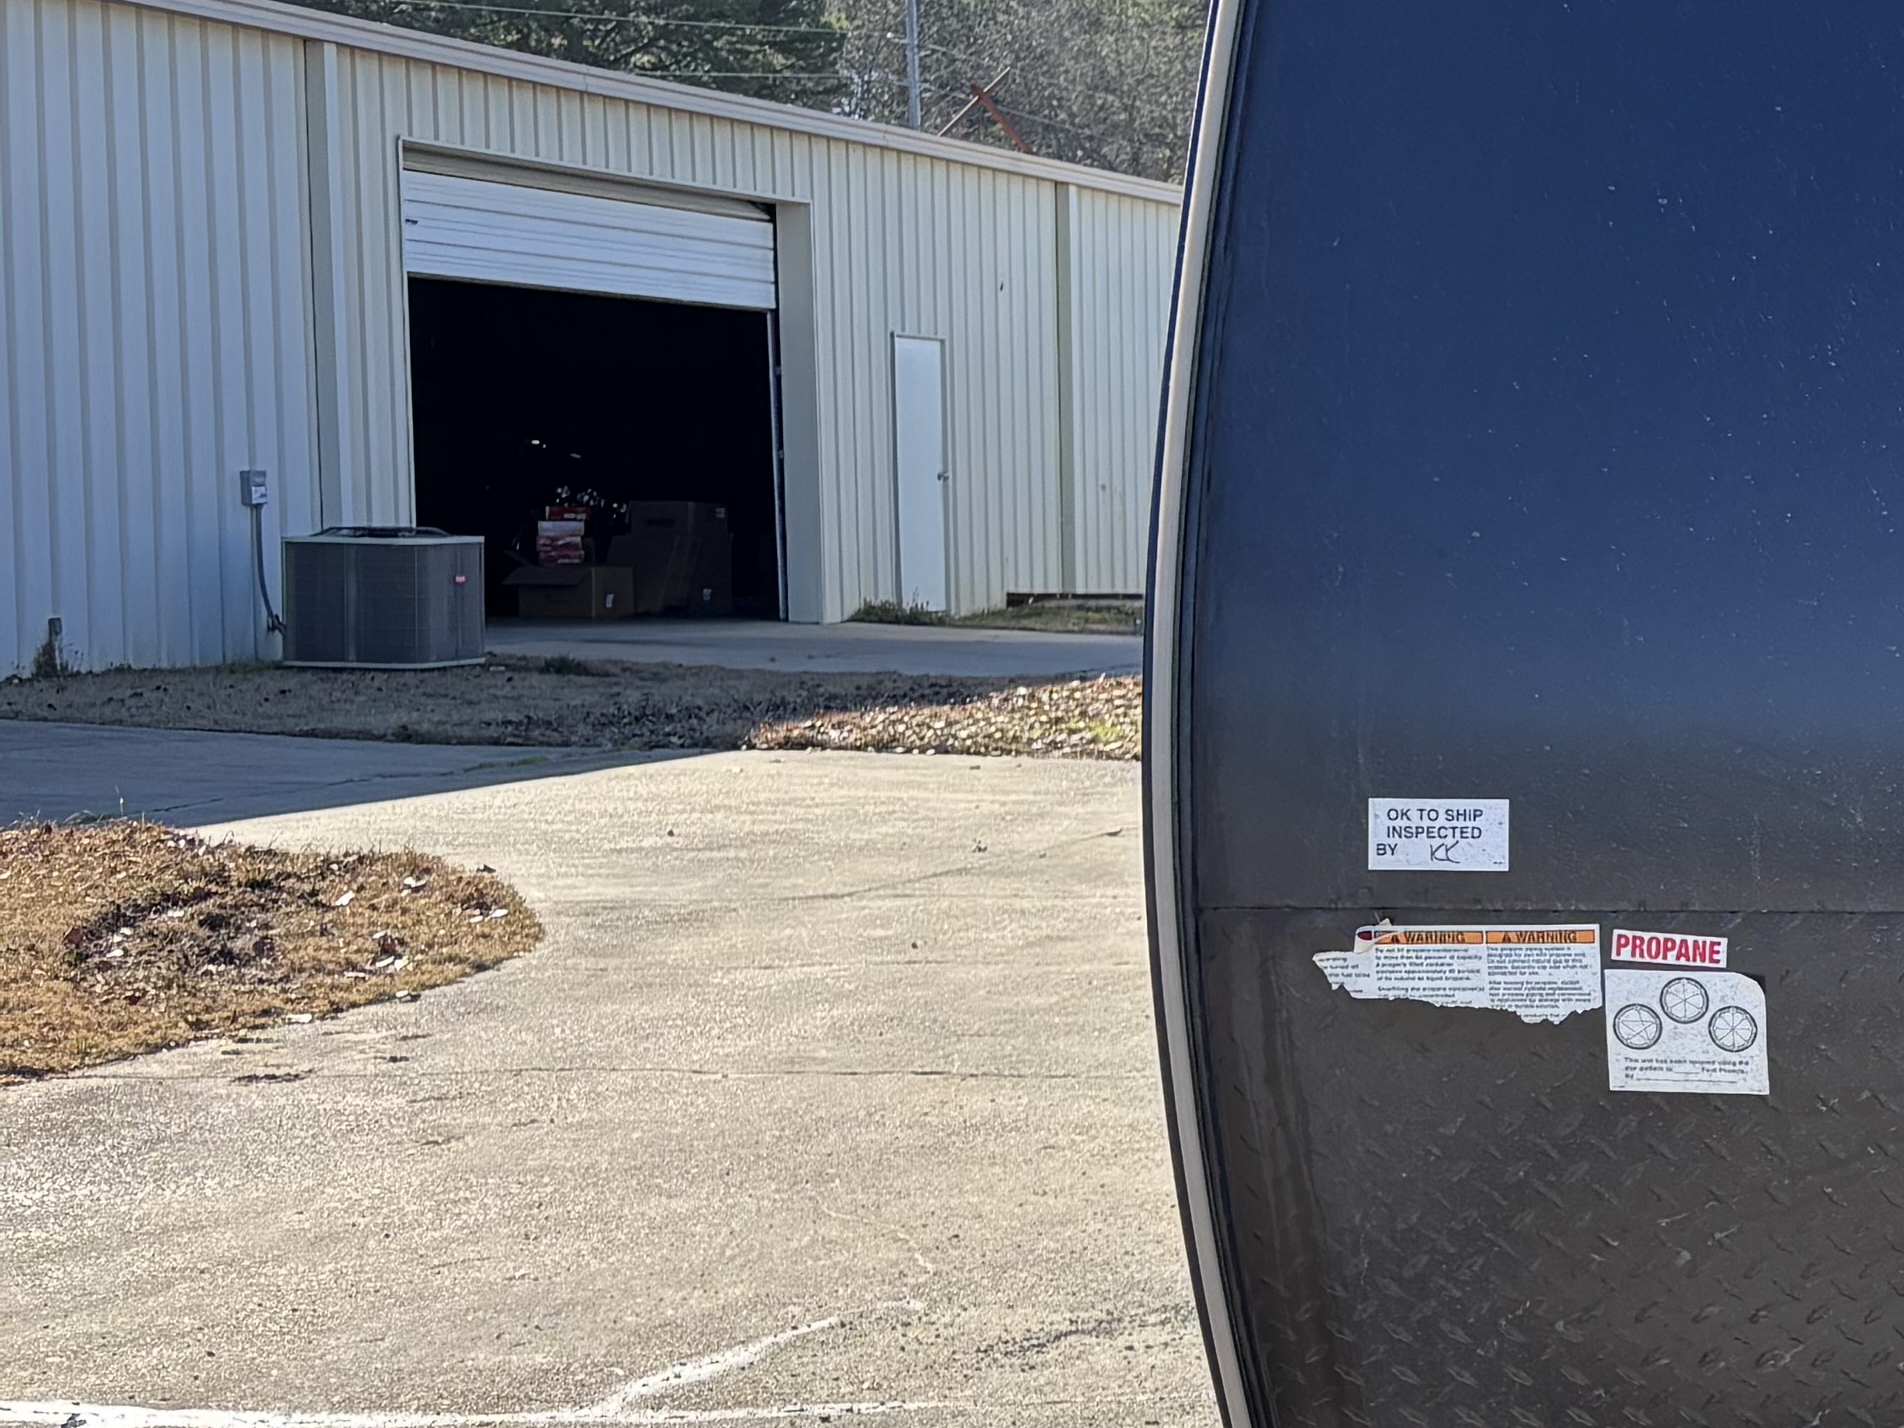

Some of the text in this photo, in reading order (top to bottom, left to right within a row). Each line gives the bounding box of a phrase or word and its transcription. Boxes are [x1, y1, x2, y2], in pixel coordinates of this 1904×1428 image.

[1387, 808, 1484, 822] OK TO SHIP
[1387, 825, 1483, 839] INSPECTED
[1376, 843, 1398, 856] BY
[1516, 930, 1577, 944] WARNING
[1615, 933, 1722, 965] PROPANE
